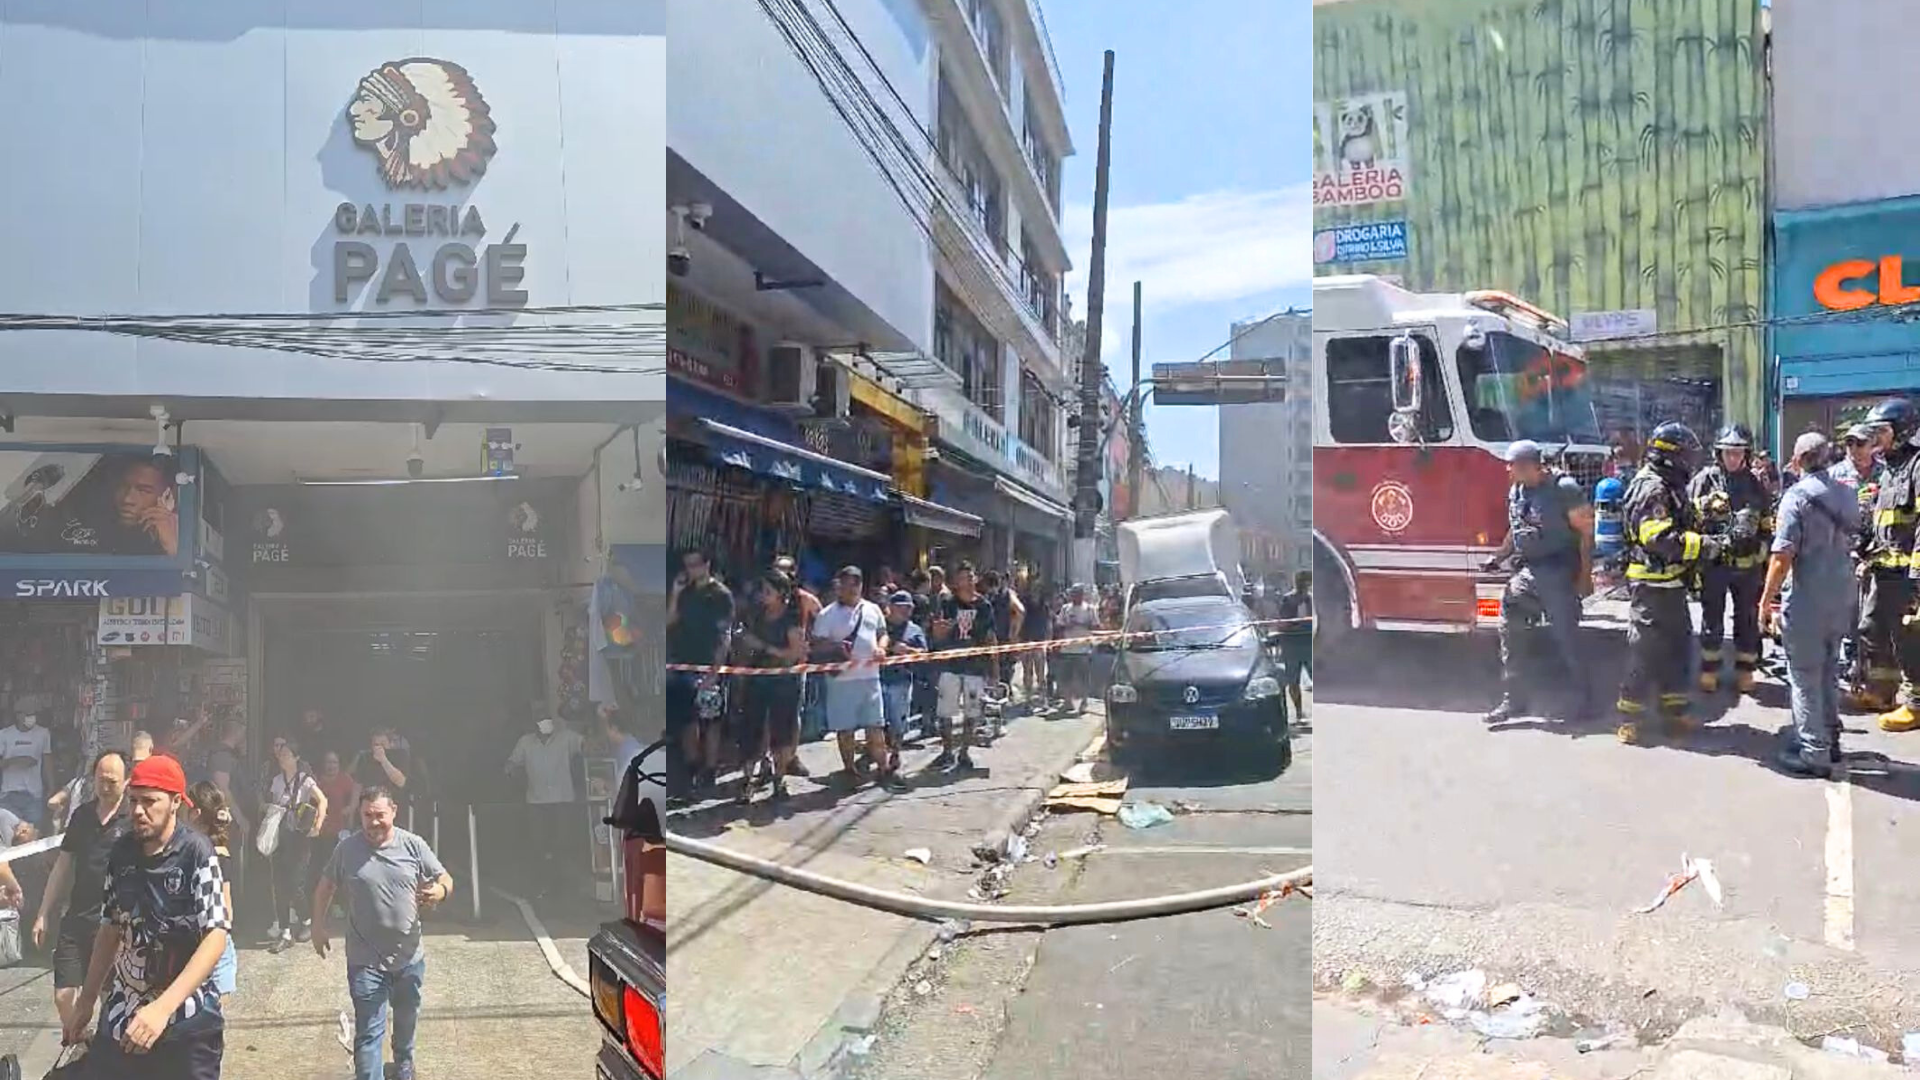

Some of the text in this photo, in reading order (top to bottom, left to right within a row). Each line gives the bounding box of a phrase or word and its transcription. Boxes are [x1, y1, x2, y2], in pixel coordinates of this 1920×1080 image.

[336, 202, 487, 236] GALERIA
[1336, 224, 1402, 244] DROGARIA
[334, 222, 529, 304] PAGÉ
[16, 579, 110, 596] SPARK
